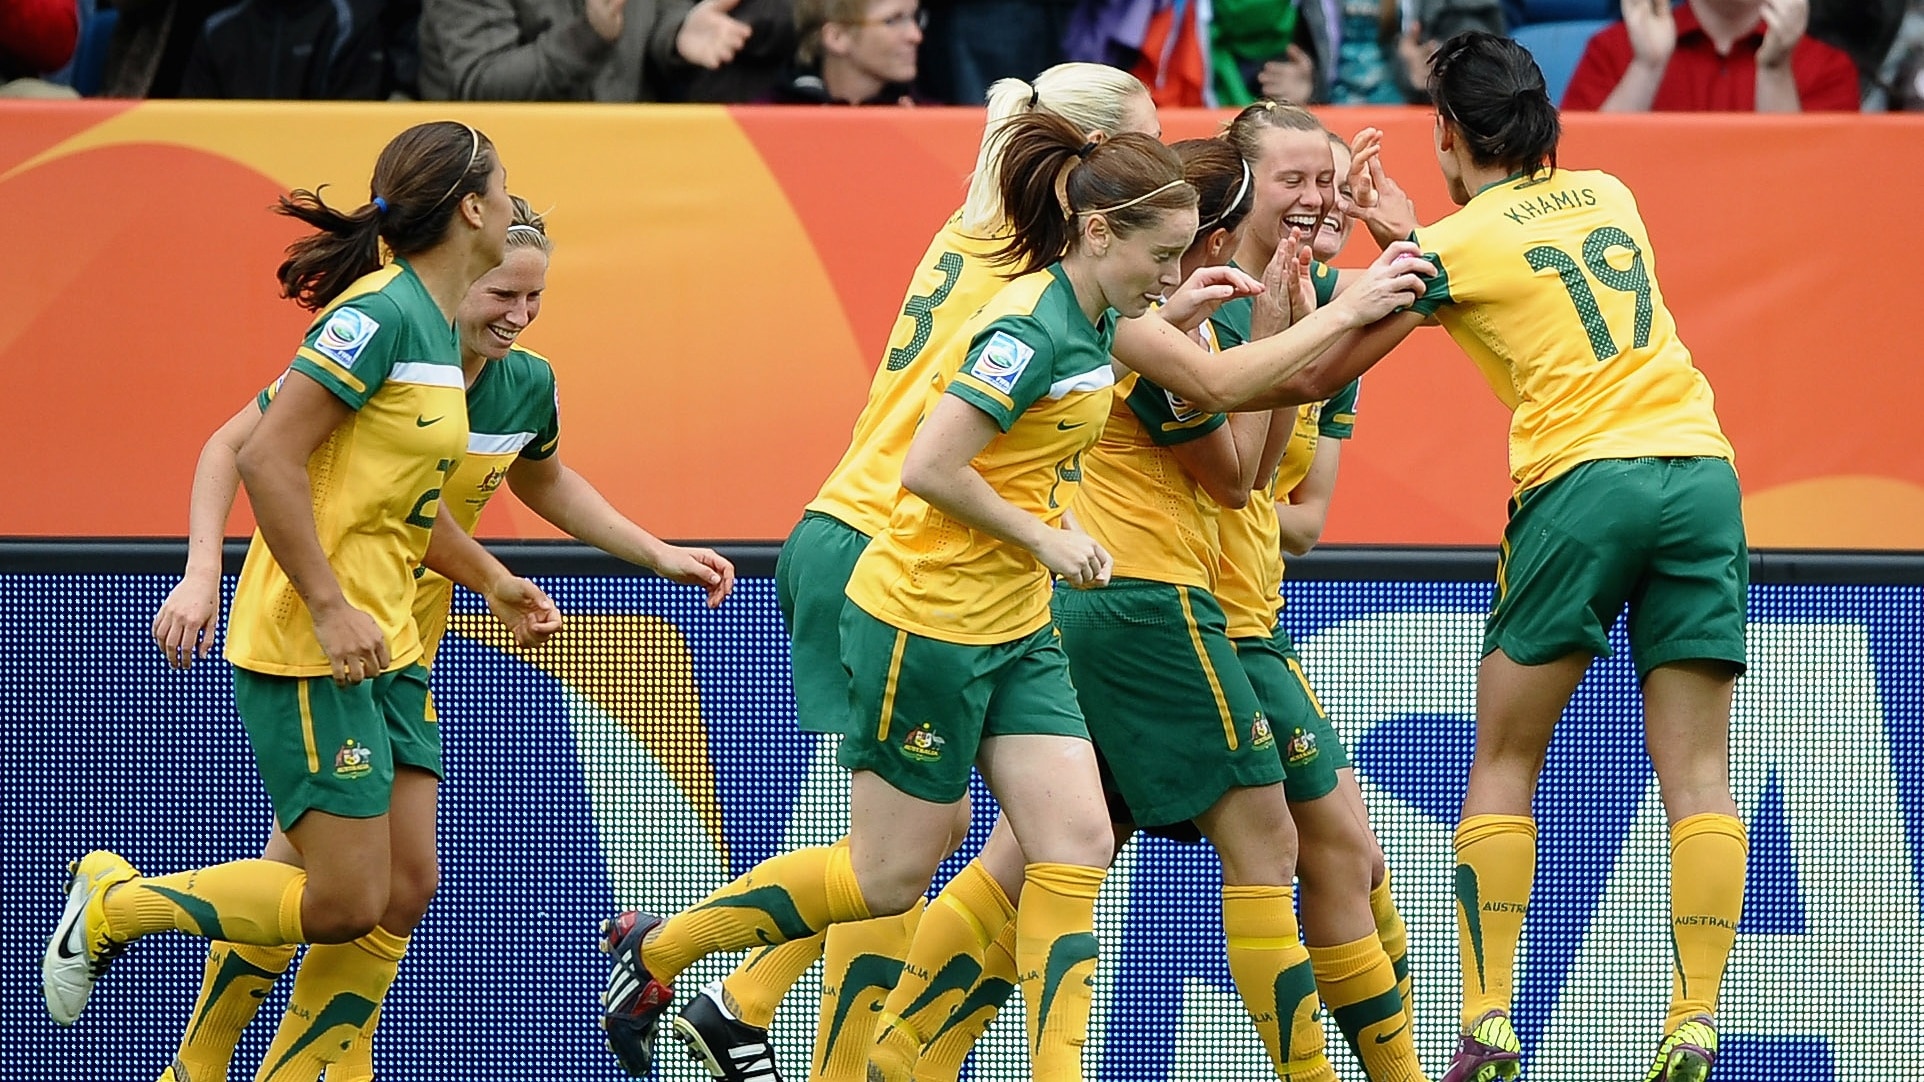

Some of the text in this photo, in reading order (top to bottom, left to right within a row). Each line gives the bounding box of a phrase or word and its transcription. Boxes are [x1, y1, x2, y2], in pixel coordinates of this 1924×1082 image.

[1503, 188, 1597, 226] KHAMIS
[886, 250, 965, 373] 3
[1523, 226, 1654, 363] 19
[447, 608, 1924, 1082] VSA
[1674, 915, 1737, 930] AUSTRALI
